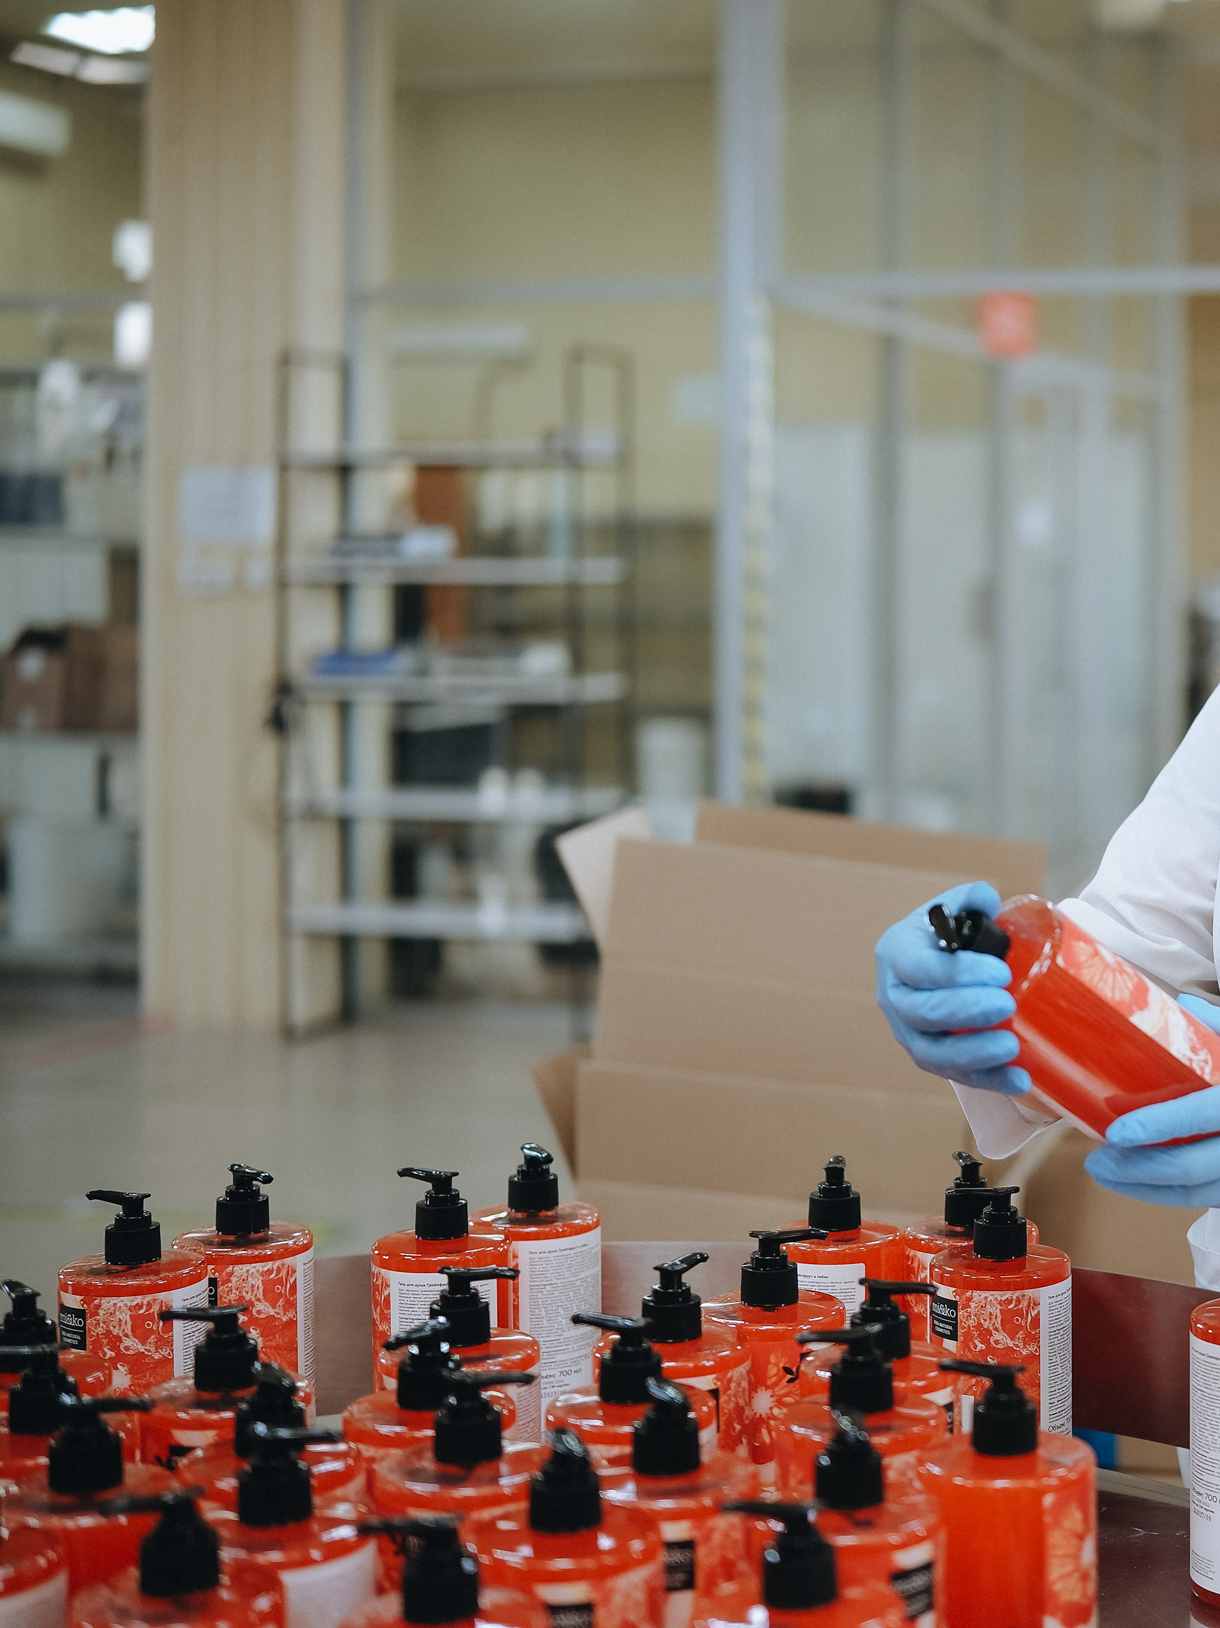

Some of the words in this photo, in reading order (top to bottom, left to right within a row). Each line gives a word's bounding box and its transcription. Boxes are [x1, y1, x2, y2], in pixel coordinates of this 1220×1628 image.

[932, 1302, 957, 1318] mi&ko
[60, 1312, 84, 1328] mi&ko
[558, 1368, 573, 1377] 700
[1205, 1492, 1218, 1503] 700
